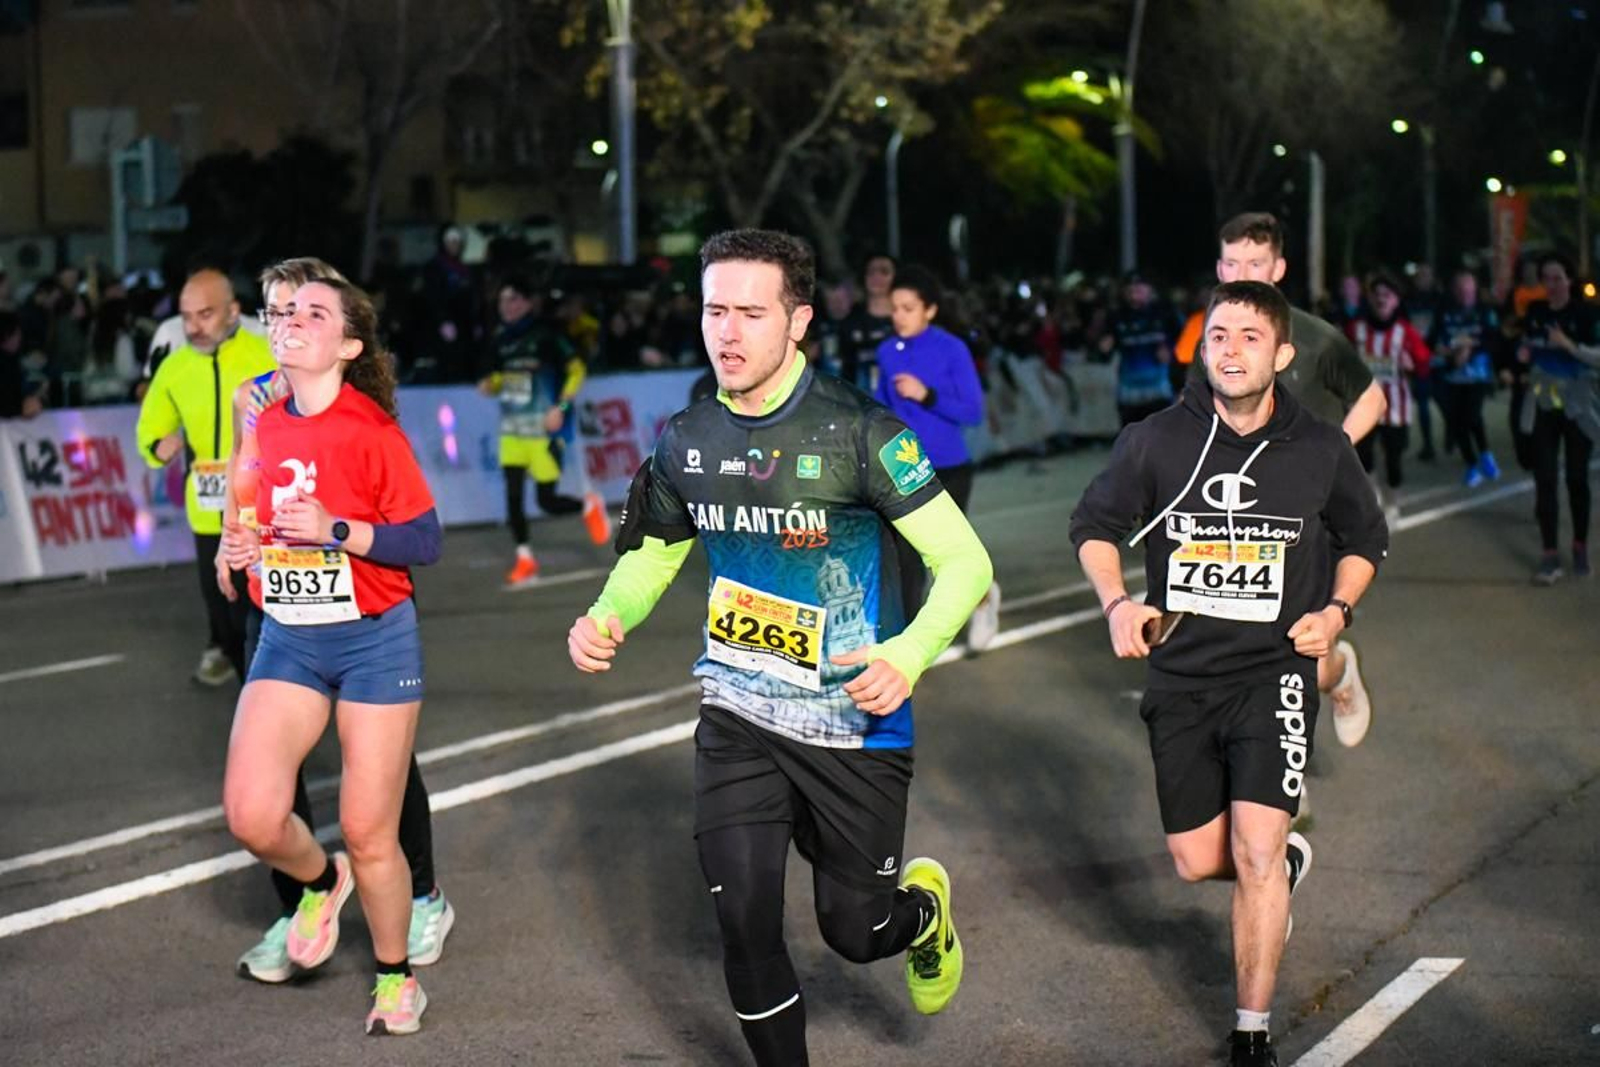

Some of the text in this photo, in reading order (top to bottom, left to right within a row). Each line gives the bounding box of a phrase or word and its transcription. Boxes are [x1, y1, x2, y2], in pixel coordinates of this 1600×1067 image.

[19, 438, 63, 487] 42
[733, 502, 827, 535] ANTÓN
[1167, 513, 1301, 541] Champion
[781, 527, 829, 549] 2025
[268, 569, 340, 595] 9637
[1179, 562, 1272, 590] 7644
[736, 591, 754, 609] 42
[715, 610, 809, 658] 4263
[1275, 673, 1307, 797] adidas
